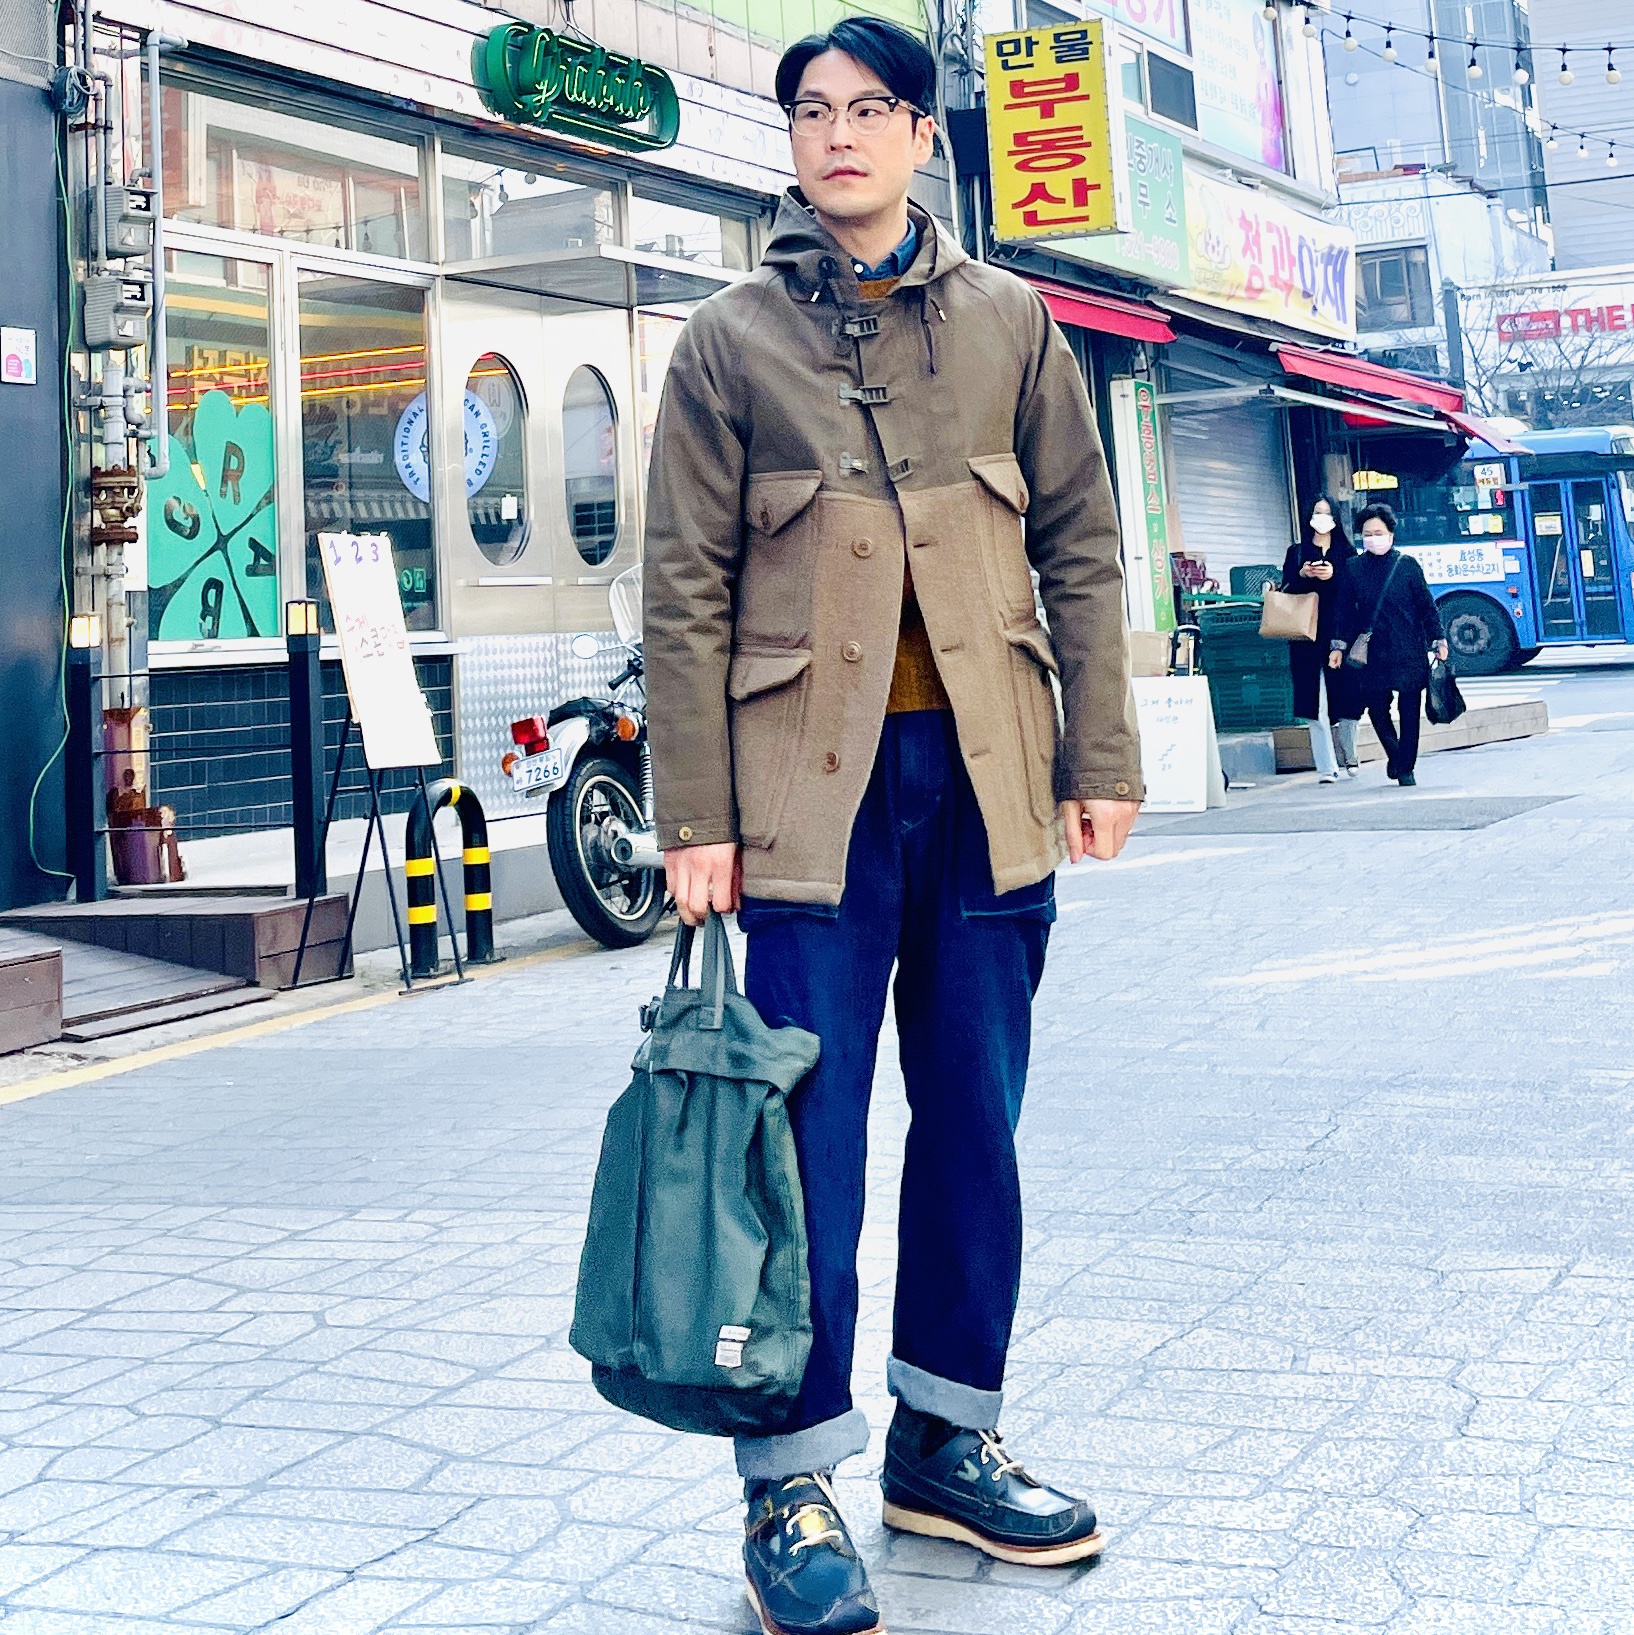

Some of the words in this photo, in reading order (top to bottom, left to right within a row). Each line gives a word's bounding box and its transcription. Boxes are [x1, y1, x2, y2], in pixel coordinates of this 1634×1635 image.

[996, 29, 1093, 71] 만물
[1003, 72, 1101, 227] 부동산
[1564, 304, 1627, 334] THE
[400, 404, 425, 487] TRADITIONAL
[473, 421, 492, 477] GRILLED
[1480, 466, 1494, 477] 45
[525, 761, 559, 785] 7266
